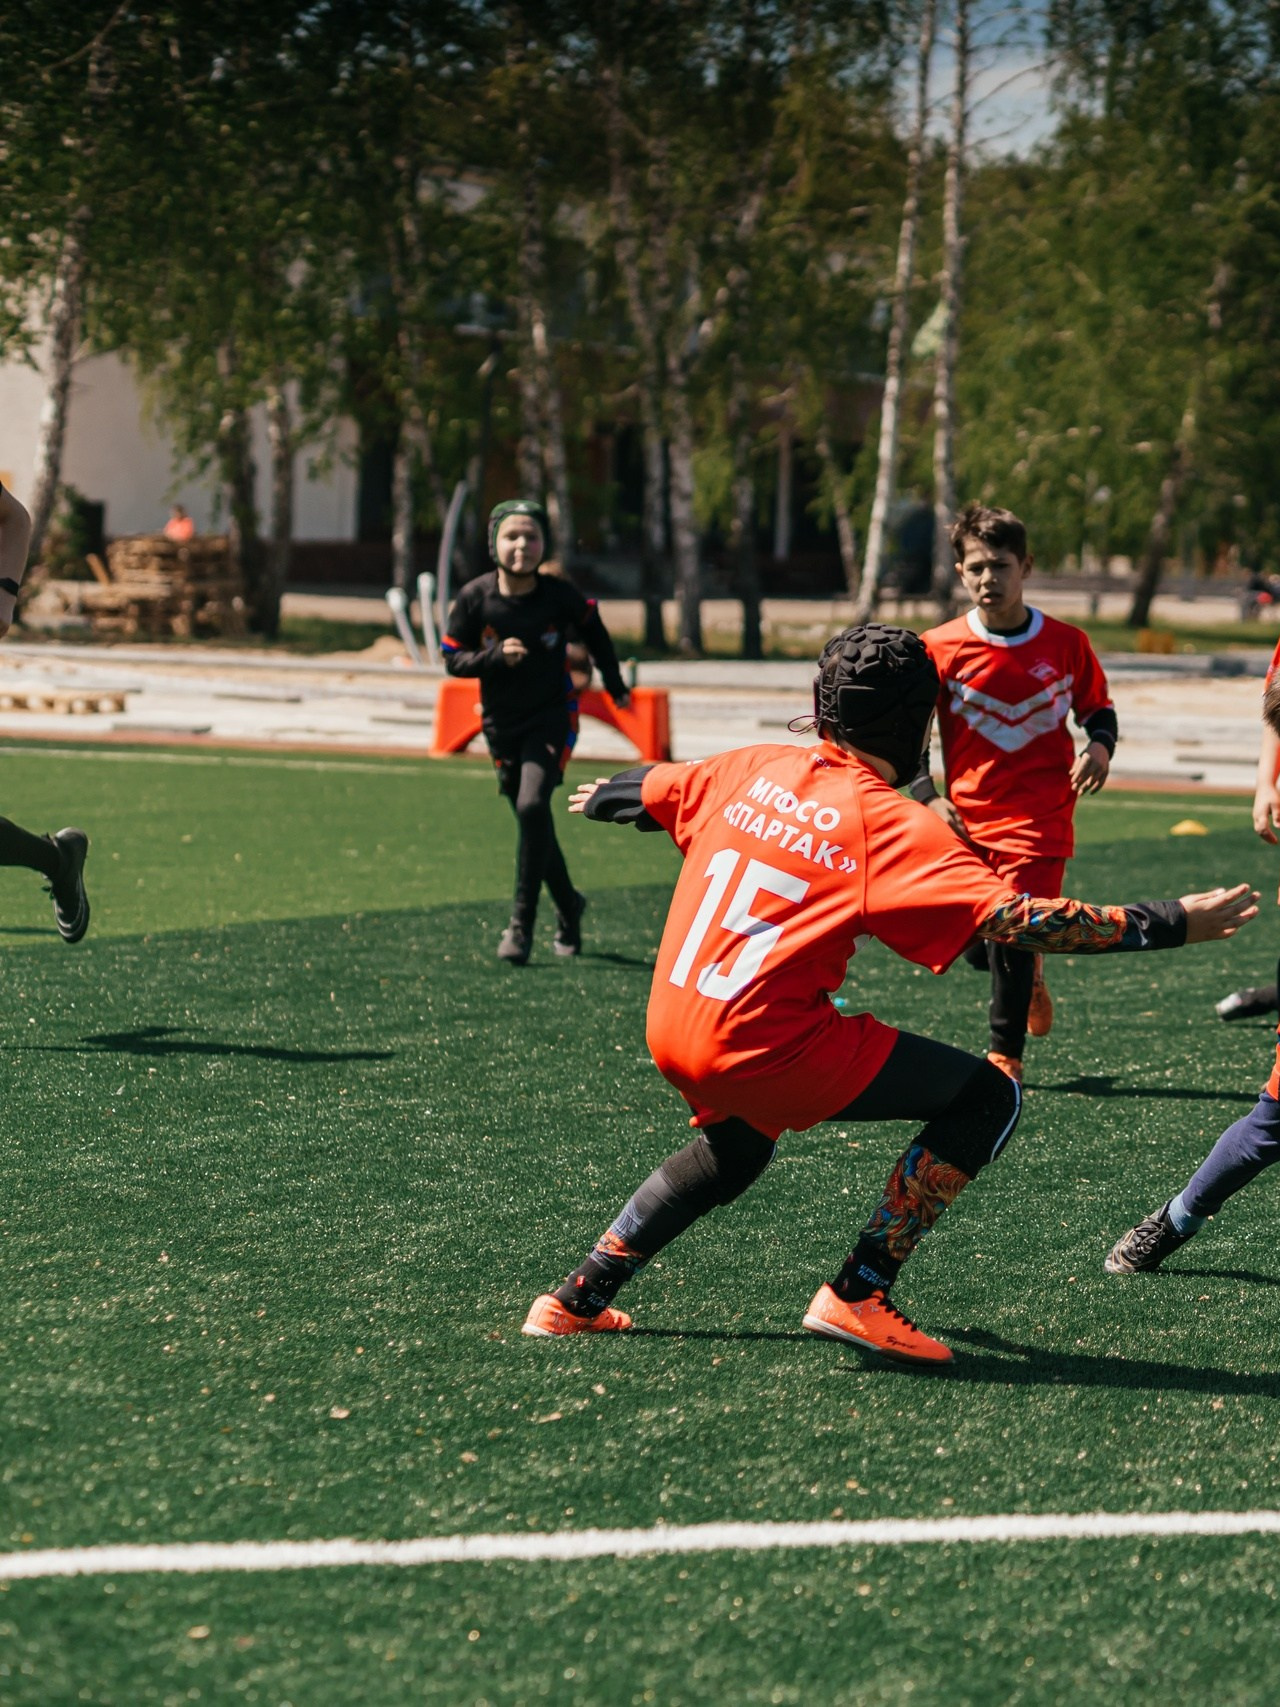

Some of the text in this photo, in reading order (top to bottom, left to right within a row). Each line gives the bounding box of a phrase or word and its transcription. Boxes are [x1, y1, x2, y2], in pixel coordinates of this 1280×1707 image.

[723, 801, 857, 875] «СПАРТАК»
[747, 776, 841, 832] МГФСО
[668, 847, 811, 1002] 15
